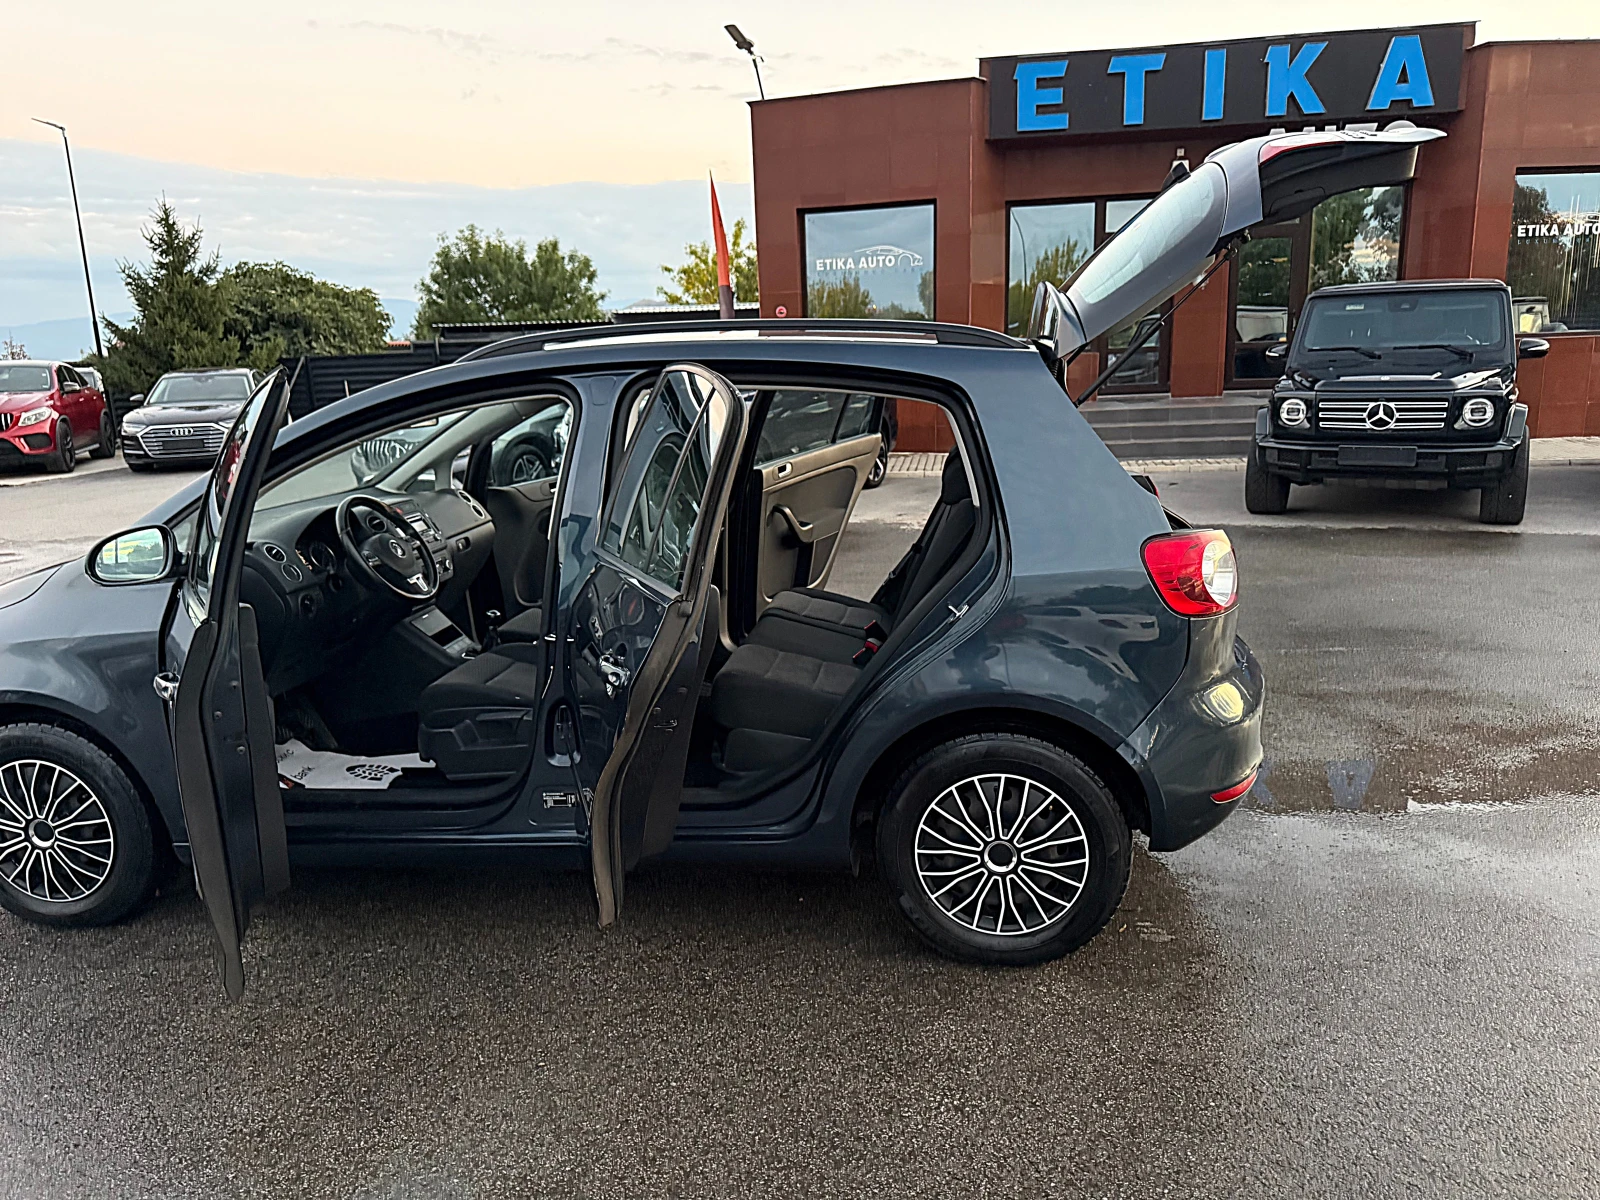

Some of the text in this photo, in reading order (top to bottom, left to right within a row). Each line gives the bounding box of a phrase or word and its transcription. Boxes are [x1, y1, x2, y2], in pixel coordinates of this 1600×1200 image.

[1013, 34, 1435, 132] ETIKA
[1517, 223, 1600, 237] ETIKA AUTO
[816, 255, 896, 271] ETIKA AUTO
